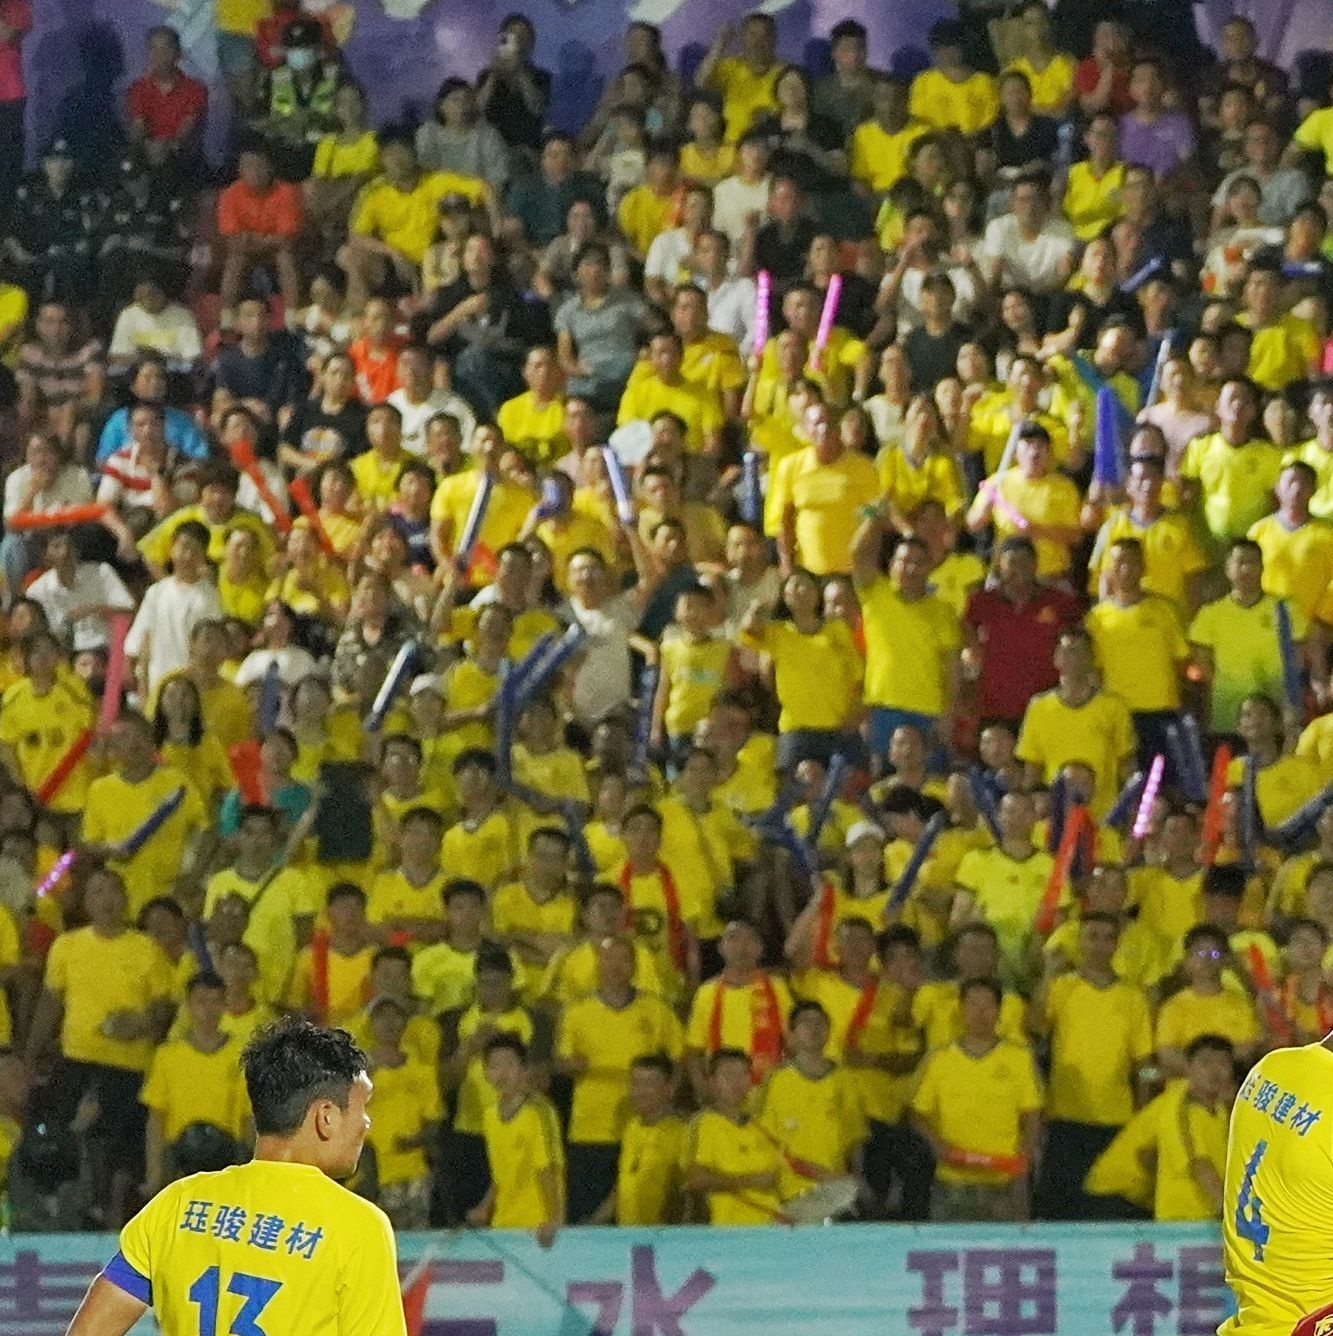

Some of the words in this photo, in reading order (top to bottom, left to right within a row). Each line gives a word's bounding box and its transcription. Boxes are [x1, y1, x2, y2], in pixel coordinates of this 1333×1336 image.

[180, 1200, 323, 1259] 珏骏建材
[1236, 1139, 1270, 1262] 4
